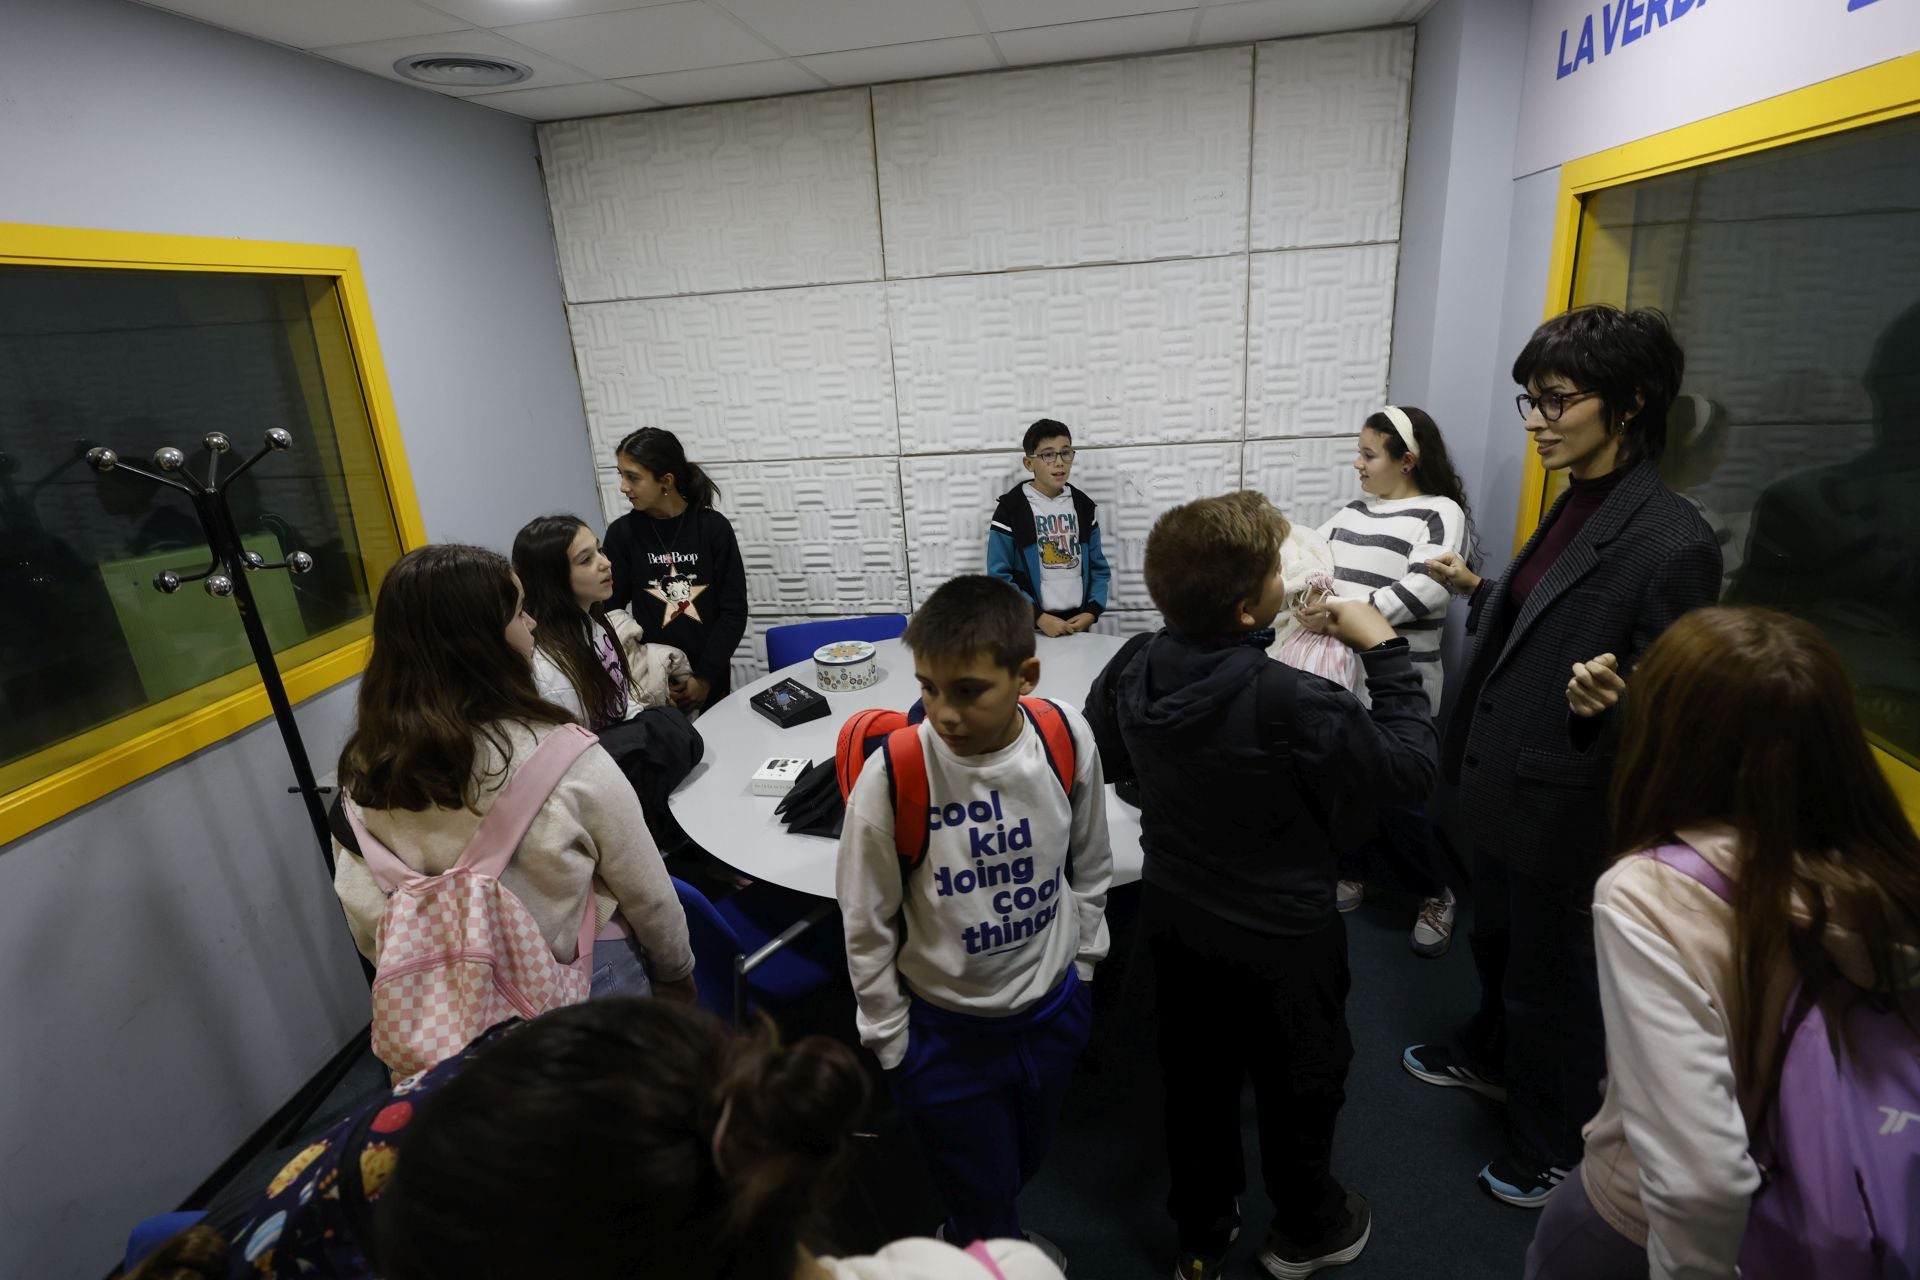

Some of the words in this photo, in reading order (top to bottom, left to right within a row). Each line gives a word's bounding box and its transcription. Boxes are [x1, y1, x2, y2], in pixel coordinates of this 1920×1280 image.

[1556, 14, 1594, 81] LA
[1035, 513, 1077, 535] ROCK
[671, 551, 698, 565] Boop
[928, 790, 1003, 831] cool
[969, 818, 1033, 858] kid
[934, 856, 1034, 896] doing
[993, 865, 1061, 914] cool
